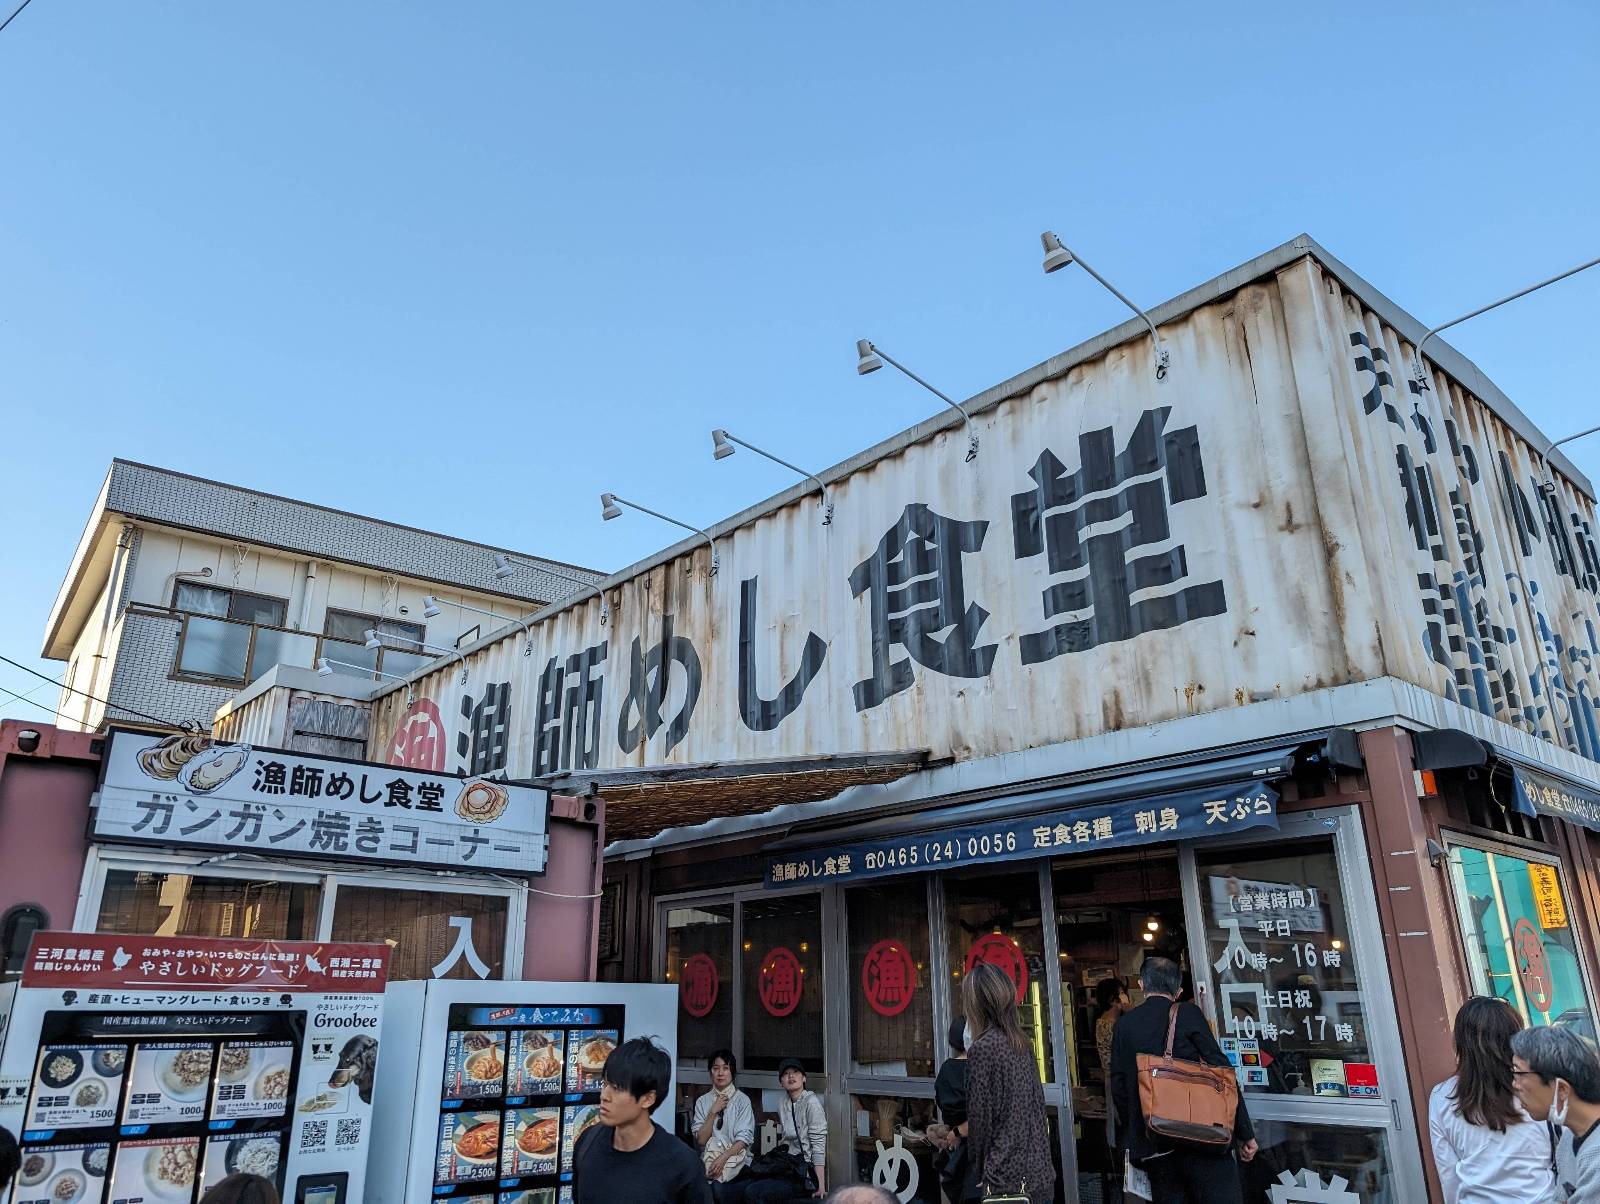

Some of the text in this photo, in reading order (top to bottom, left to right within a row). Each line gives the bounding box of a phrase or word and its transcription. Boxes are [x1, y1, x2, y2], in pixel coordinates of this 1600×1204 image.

[457, 406, 1227, 780] 漁師めし食堂
[252, 758, 444, 812] 漁師めし食堂
[131, 793, 521, 861] ガンガン焼きコーナー
[772, 793, 1272, 882] 漁師めし食堂 0465(24)0056 定食各種 刺身 天ぷら
[1230, 888, 1318, 912] 【営業時間】
[1258, 920, 1291, 937] 平日
[432, 916, 490, 979] 入
[139, 960, 300, 979] やさしいドッグフード
[868, 946, 909, 1008] 漁
[1261, 989, 1312, 1009] 土日祝
[176, 1016, 252, 1025] やさしいドッグフード
[314, 1012, 378, 1028] Groobee
[1350, 1086, 1379, 1095] SEOM
